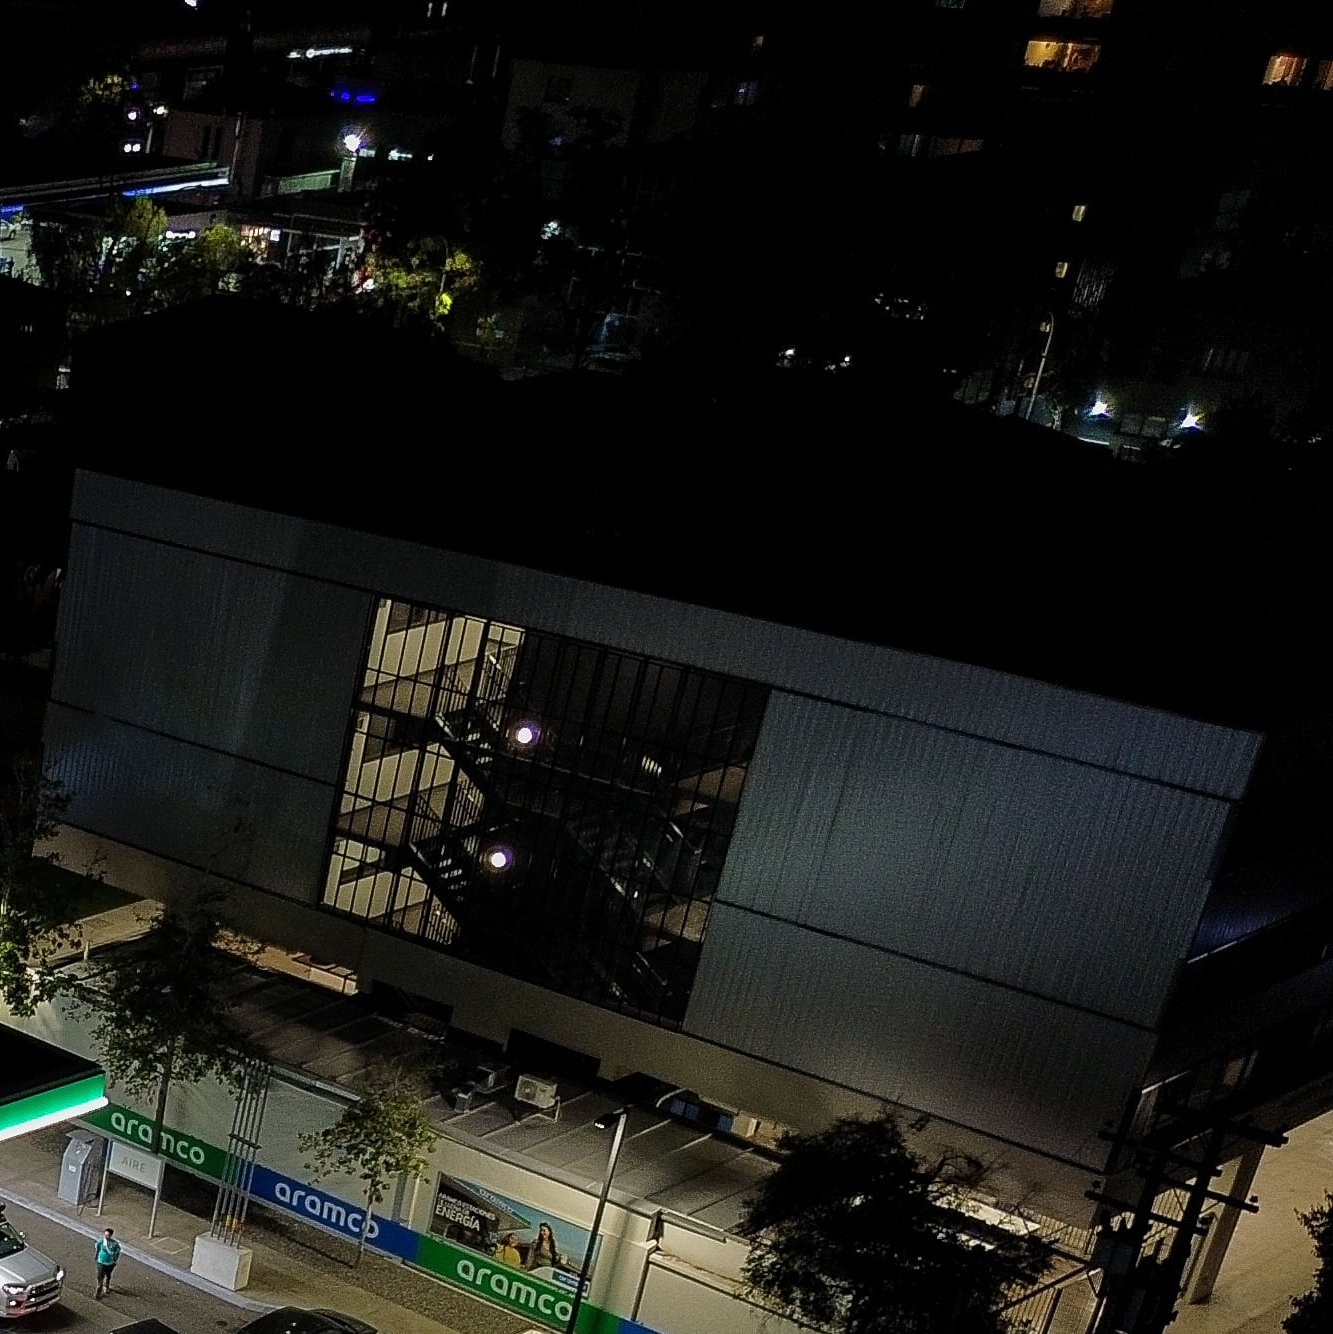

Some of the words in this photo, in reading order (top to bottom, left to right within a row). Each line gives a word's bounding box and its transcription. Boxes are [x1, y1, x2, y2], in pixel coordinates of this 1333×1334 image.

[121, 1155, 146, 1174] AIRE
[274, 1181, 380, 1240] aramco
[435, 1204, 480, 1232] ENERGÍA
[456, 1259, 574, 1322] aramco
